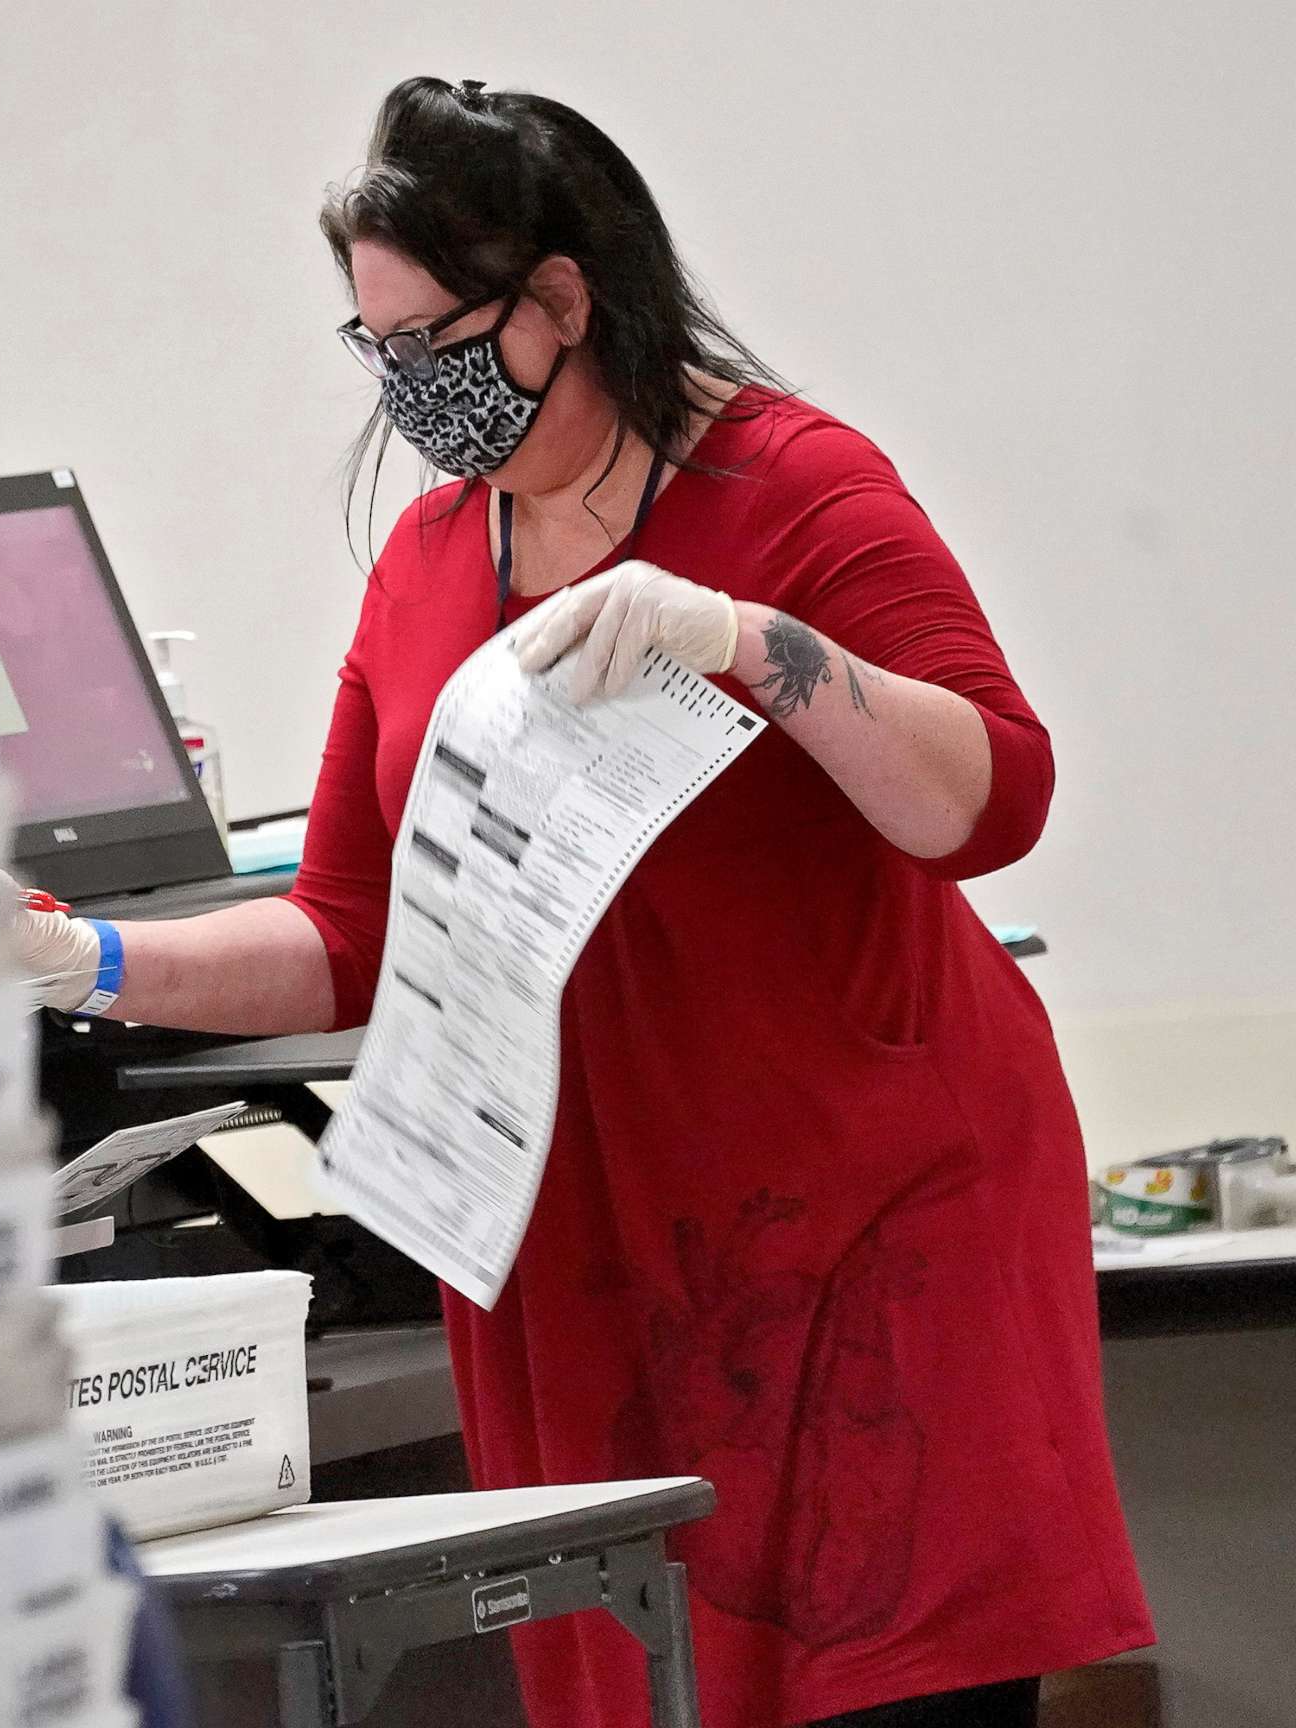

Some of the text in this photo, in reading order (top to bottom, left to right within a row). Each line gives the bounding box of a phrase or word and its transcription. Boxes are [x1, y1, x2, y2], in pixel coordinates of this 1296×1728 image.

[68, 1345, 257, 1408] TES POSTAL SERVICE
[94, 1426, 133, 1443] WARNING
[97, 1457, 108, 1466] MAIL
[97, 1468, 106, 1476] THE
[107, 1464, 130, 1474] LOCATION
